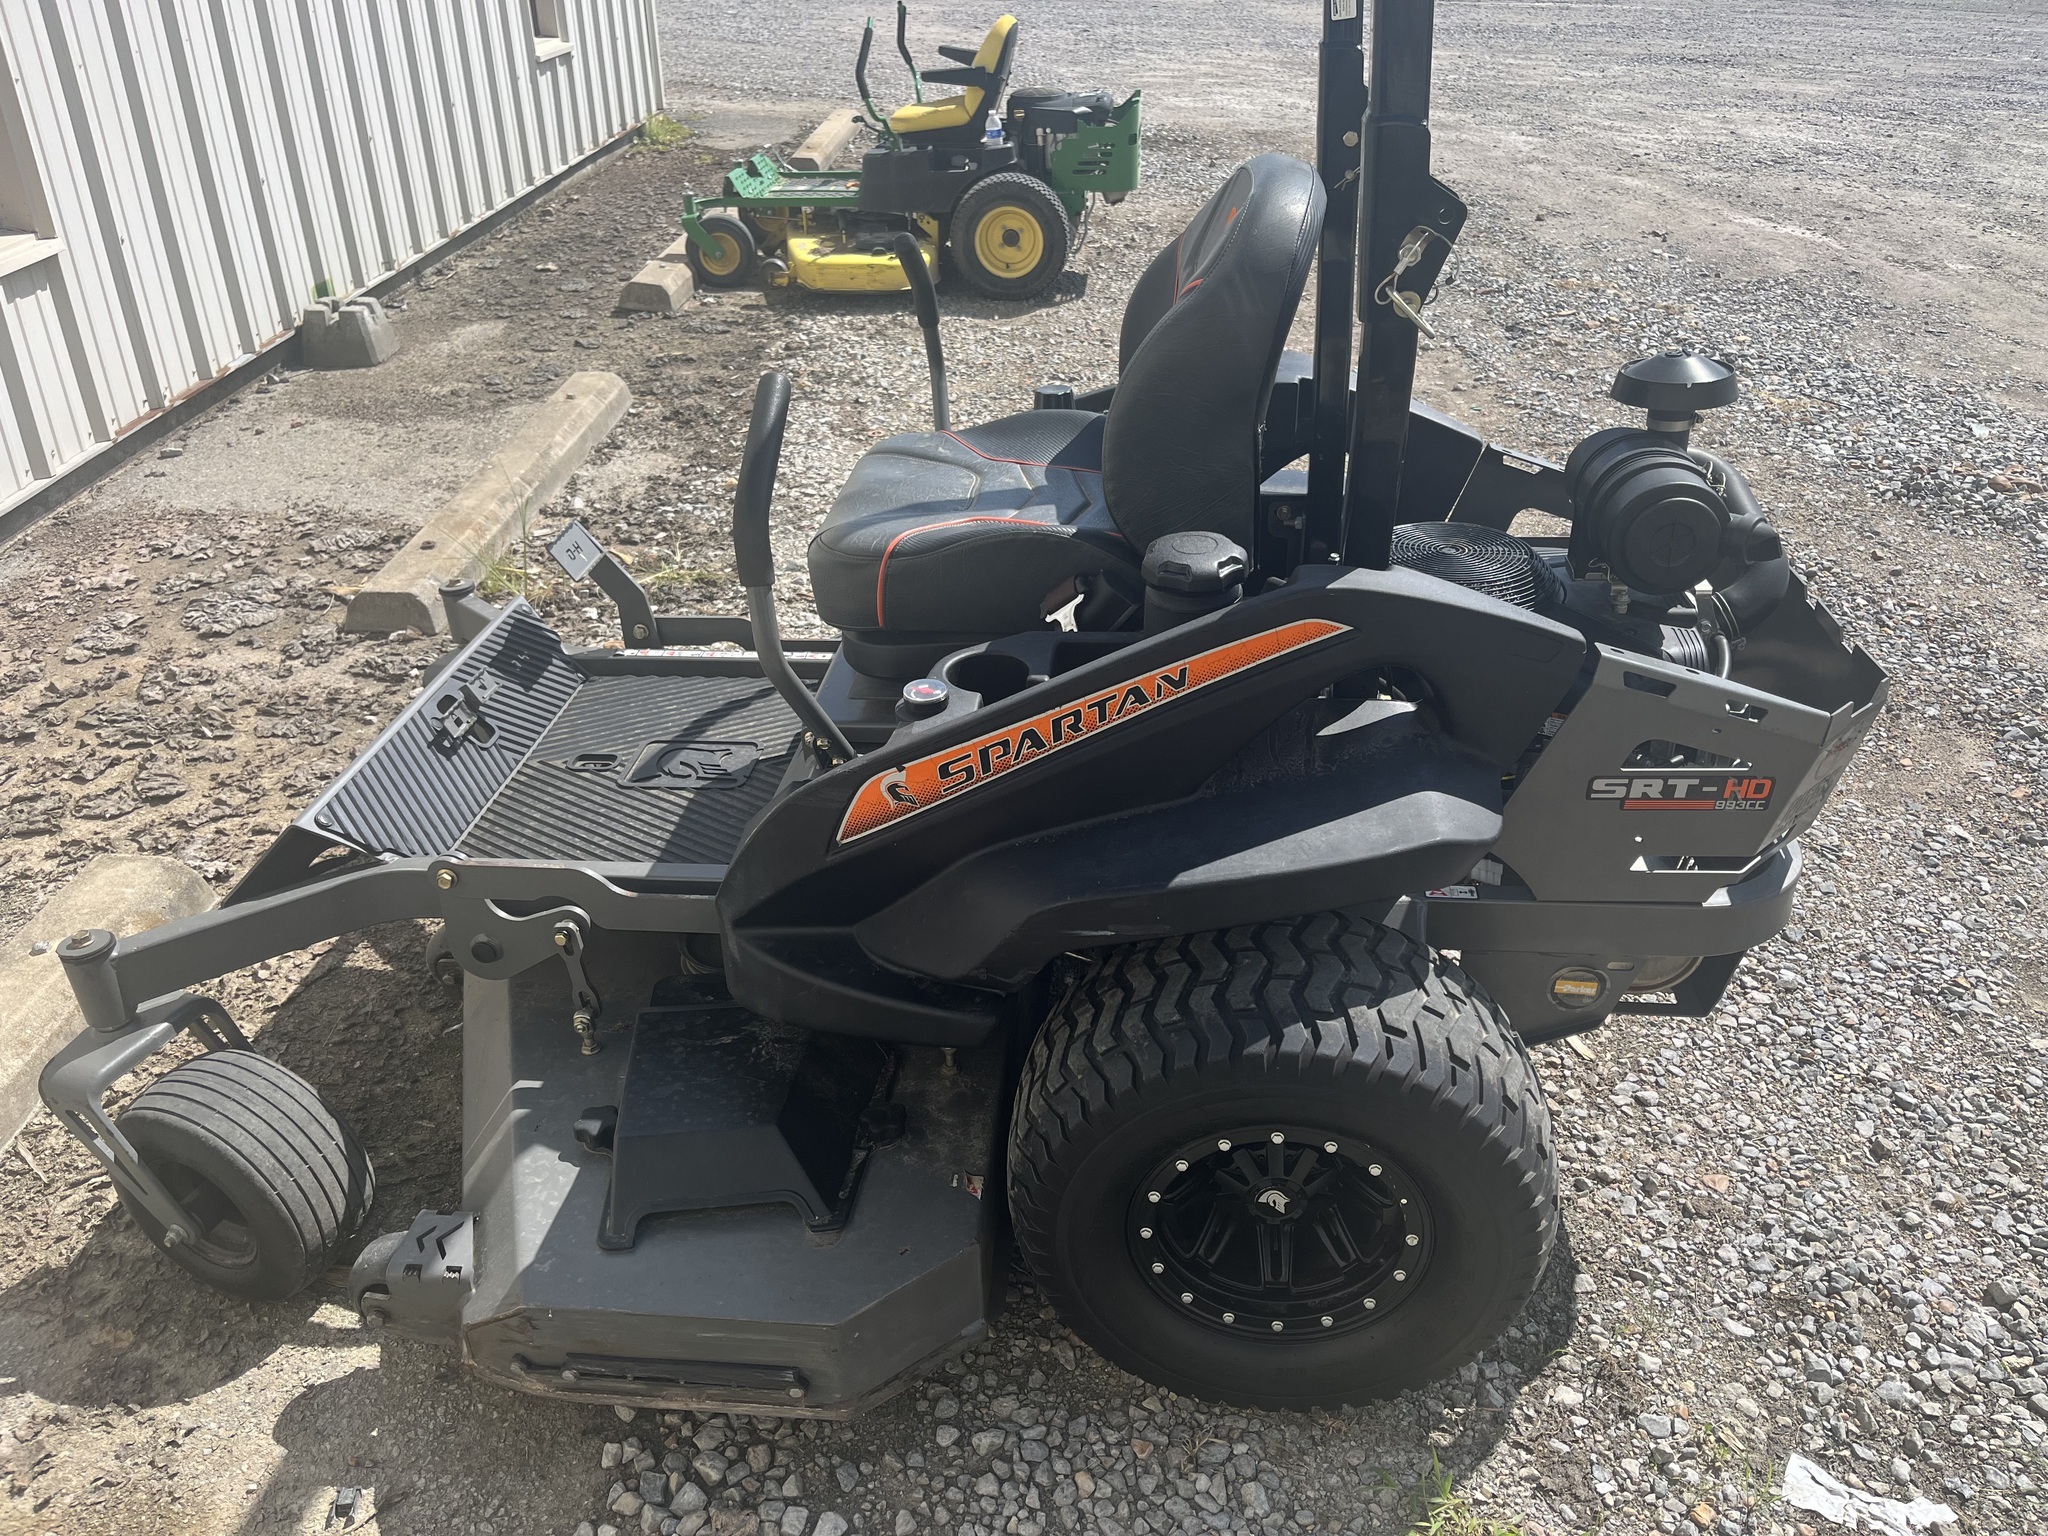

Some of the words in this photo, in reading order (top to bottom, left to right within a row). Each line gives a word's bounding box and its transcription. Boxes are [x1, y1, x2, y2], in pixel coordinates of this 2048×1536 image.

[938, 665, 1190, 794] SPARTAN
[1590, 778, 1772, 799] SRT-HD
[1714, 800, 1766, 811] 993CC
[1562, 984, 1597, 995] Parker
